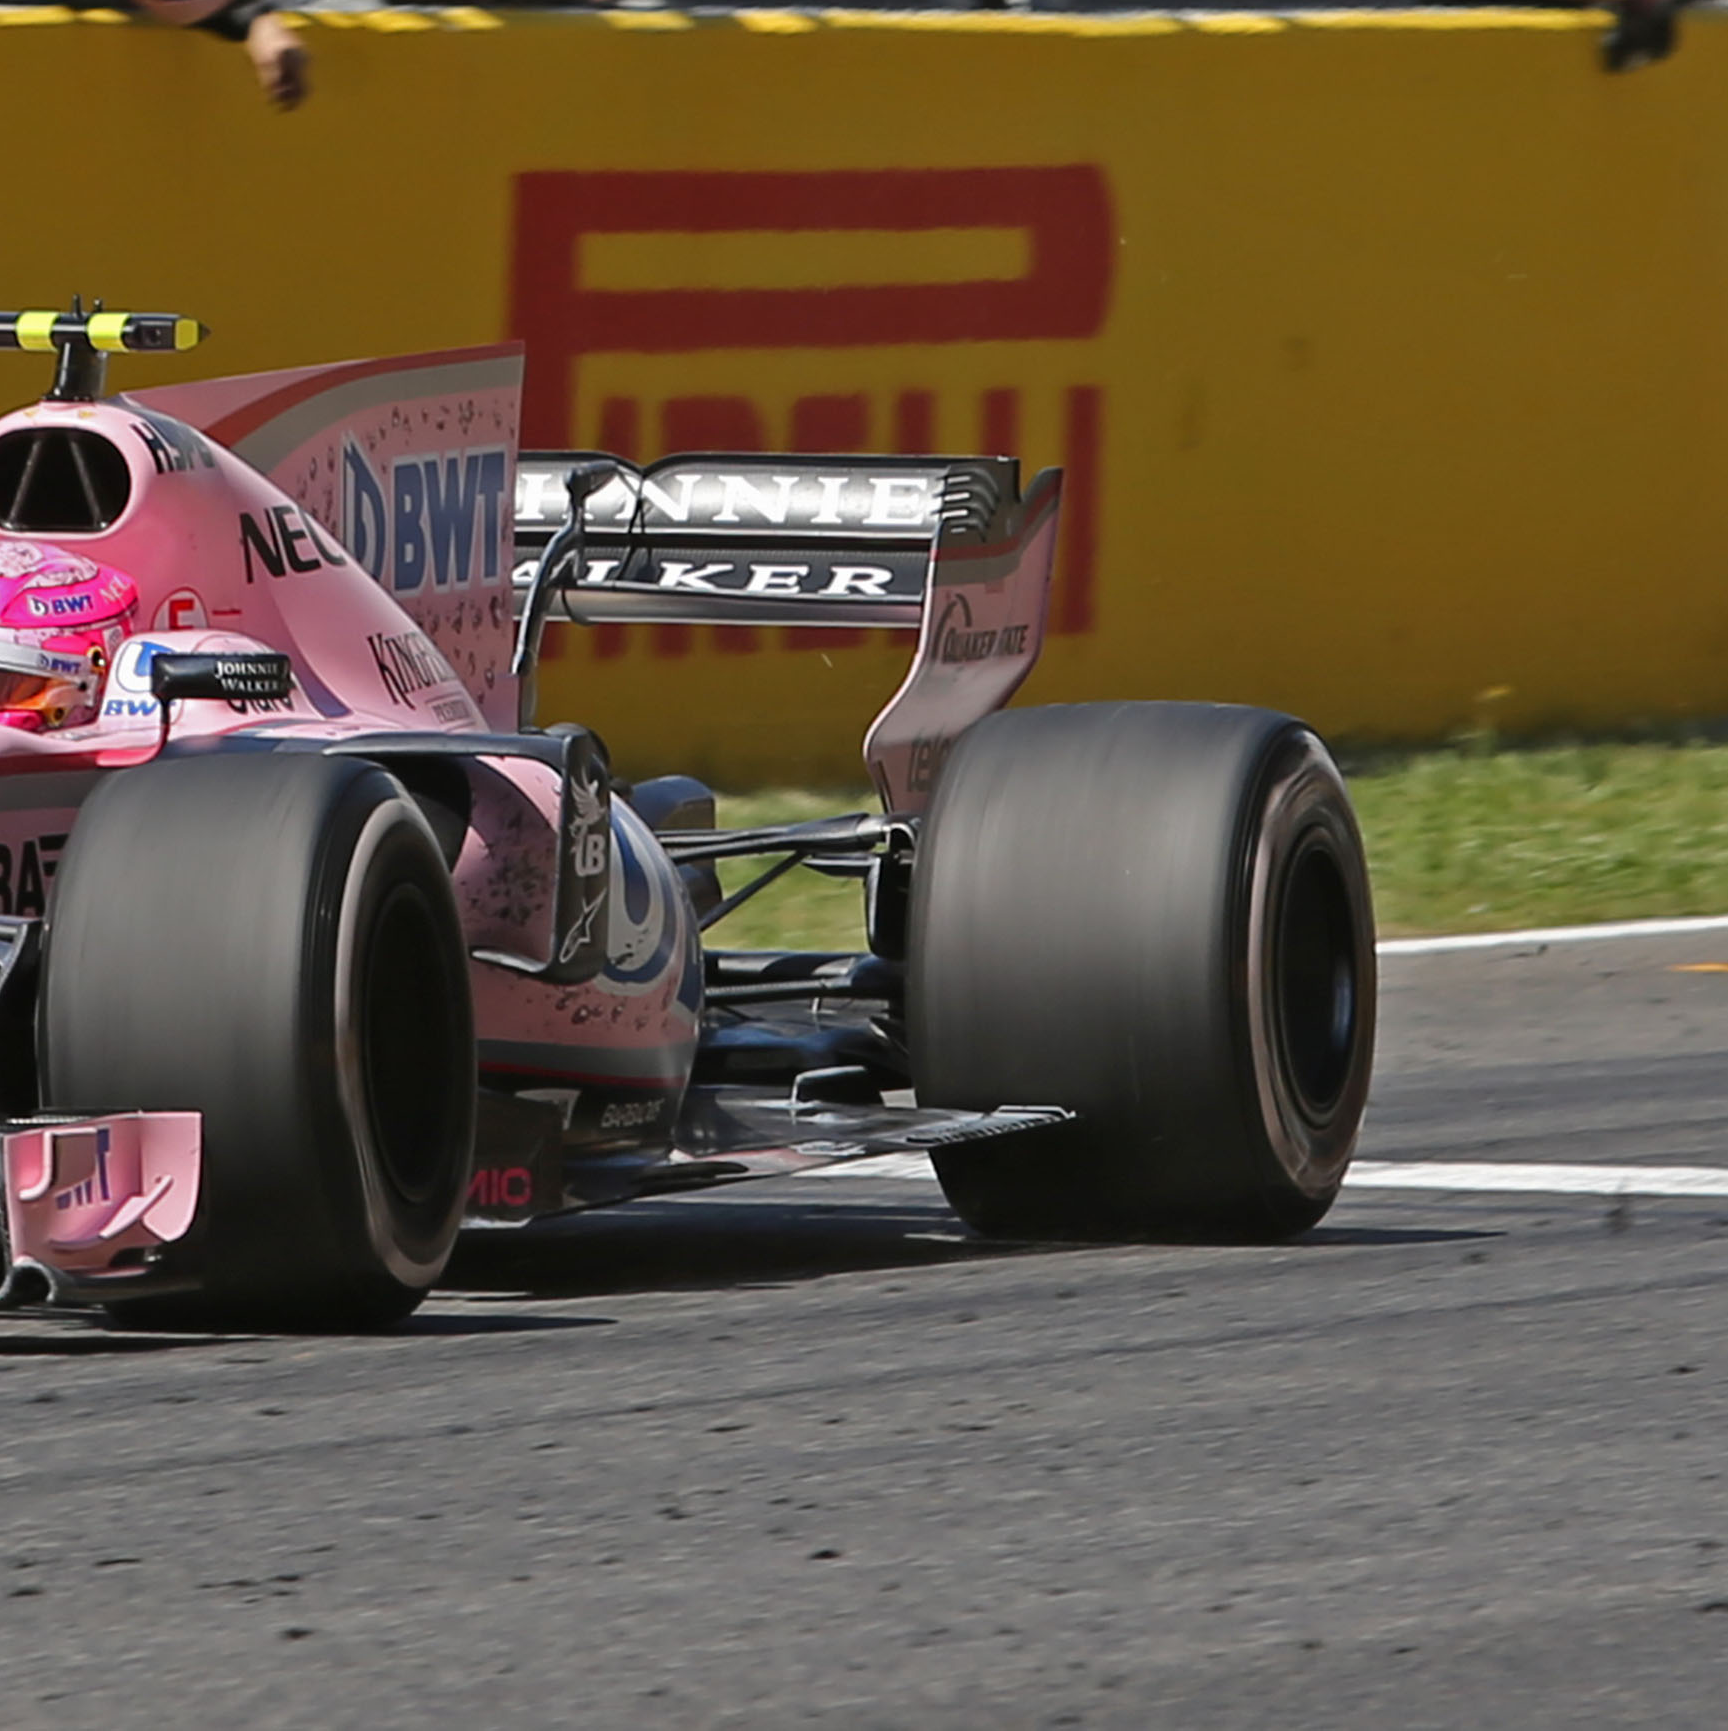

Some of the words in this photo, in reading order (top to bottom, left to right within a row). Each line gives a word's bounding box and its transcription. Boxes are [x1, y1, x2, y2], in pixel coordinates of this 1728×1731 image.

[394, 451, 506, 592] BWT
[52, 595, 93, 615] BWT
[50, 658, 81, 675] BWT
